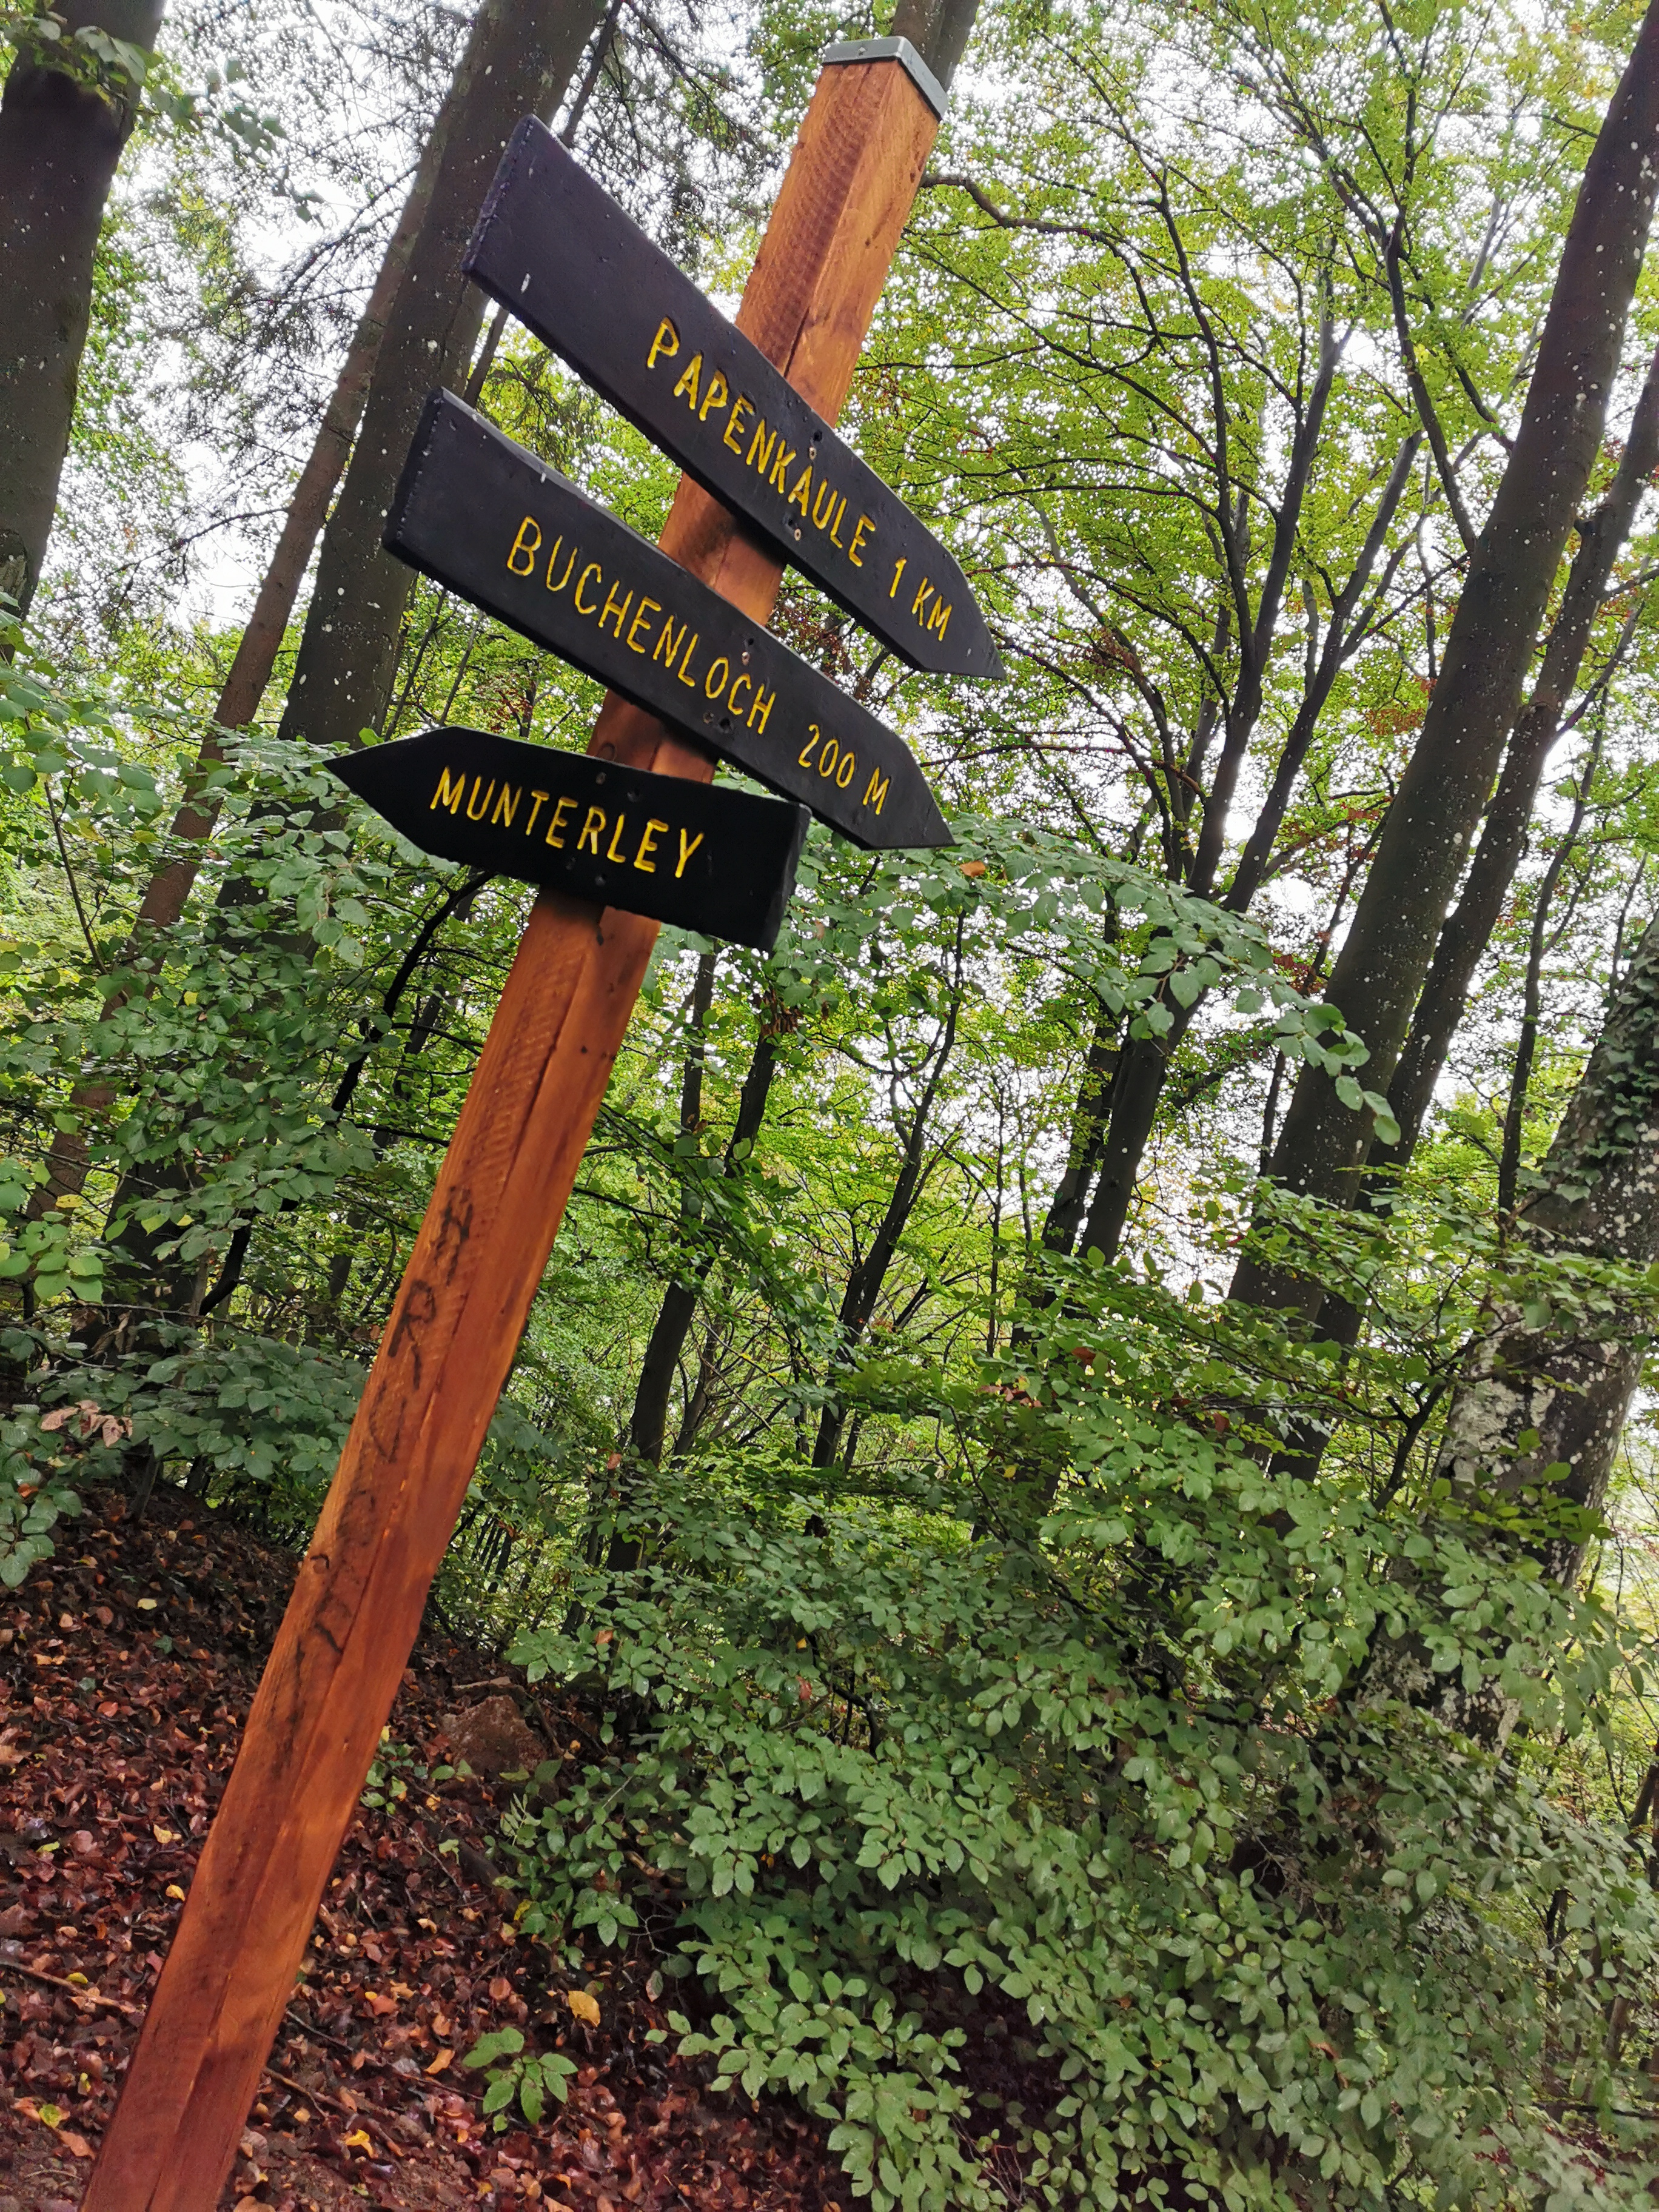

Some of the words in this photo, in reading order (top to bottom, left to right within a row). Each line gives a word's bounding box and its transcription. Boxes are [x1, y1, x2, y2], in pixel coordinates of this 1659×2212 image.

[646, 317, 877, 568] PAPENKAULE
[889, 557, 908, 598] 1
[911, 576, 953, 642] KM
[506, 515, 777, 736] BUCHENLOCH
[797, 723, 856, 789] 200
[862, 766, 891, 816] M
[429, 765, 705, 879] MUNTERLEY
